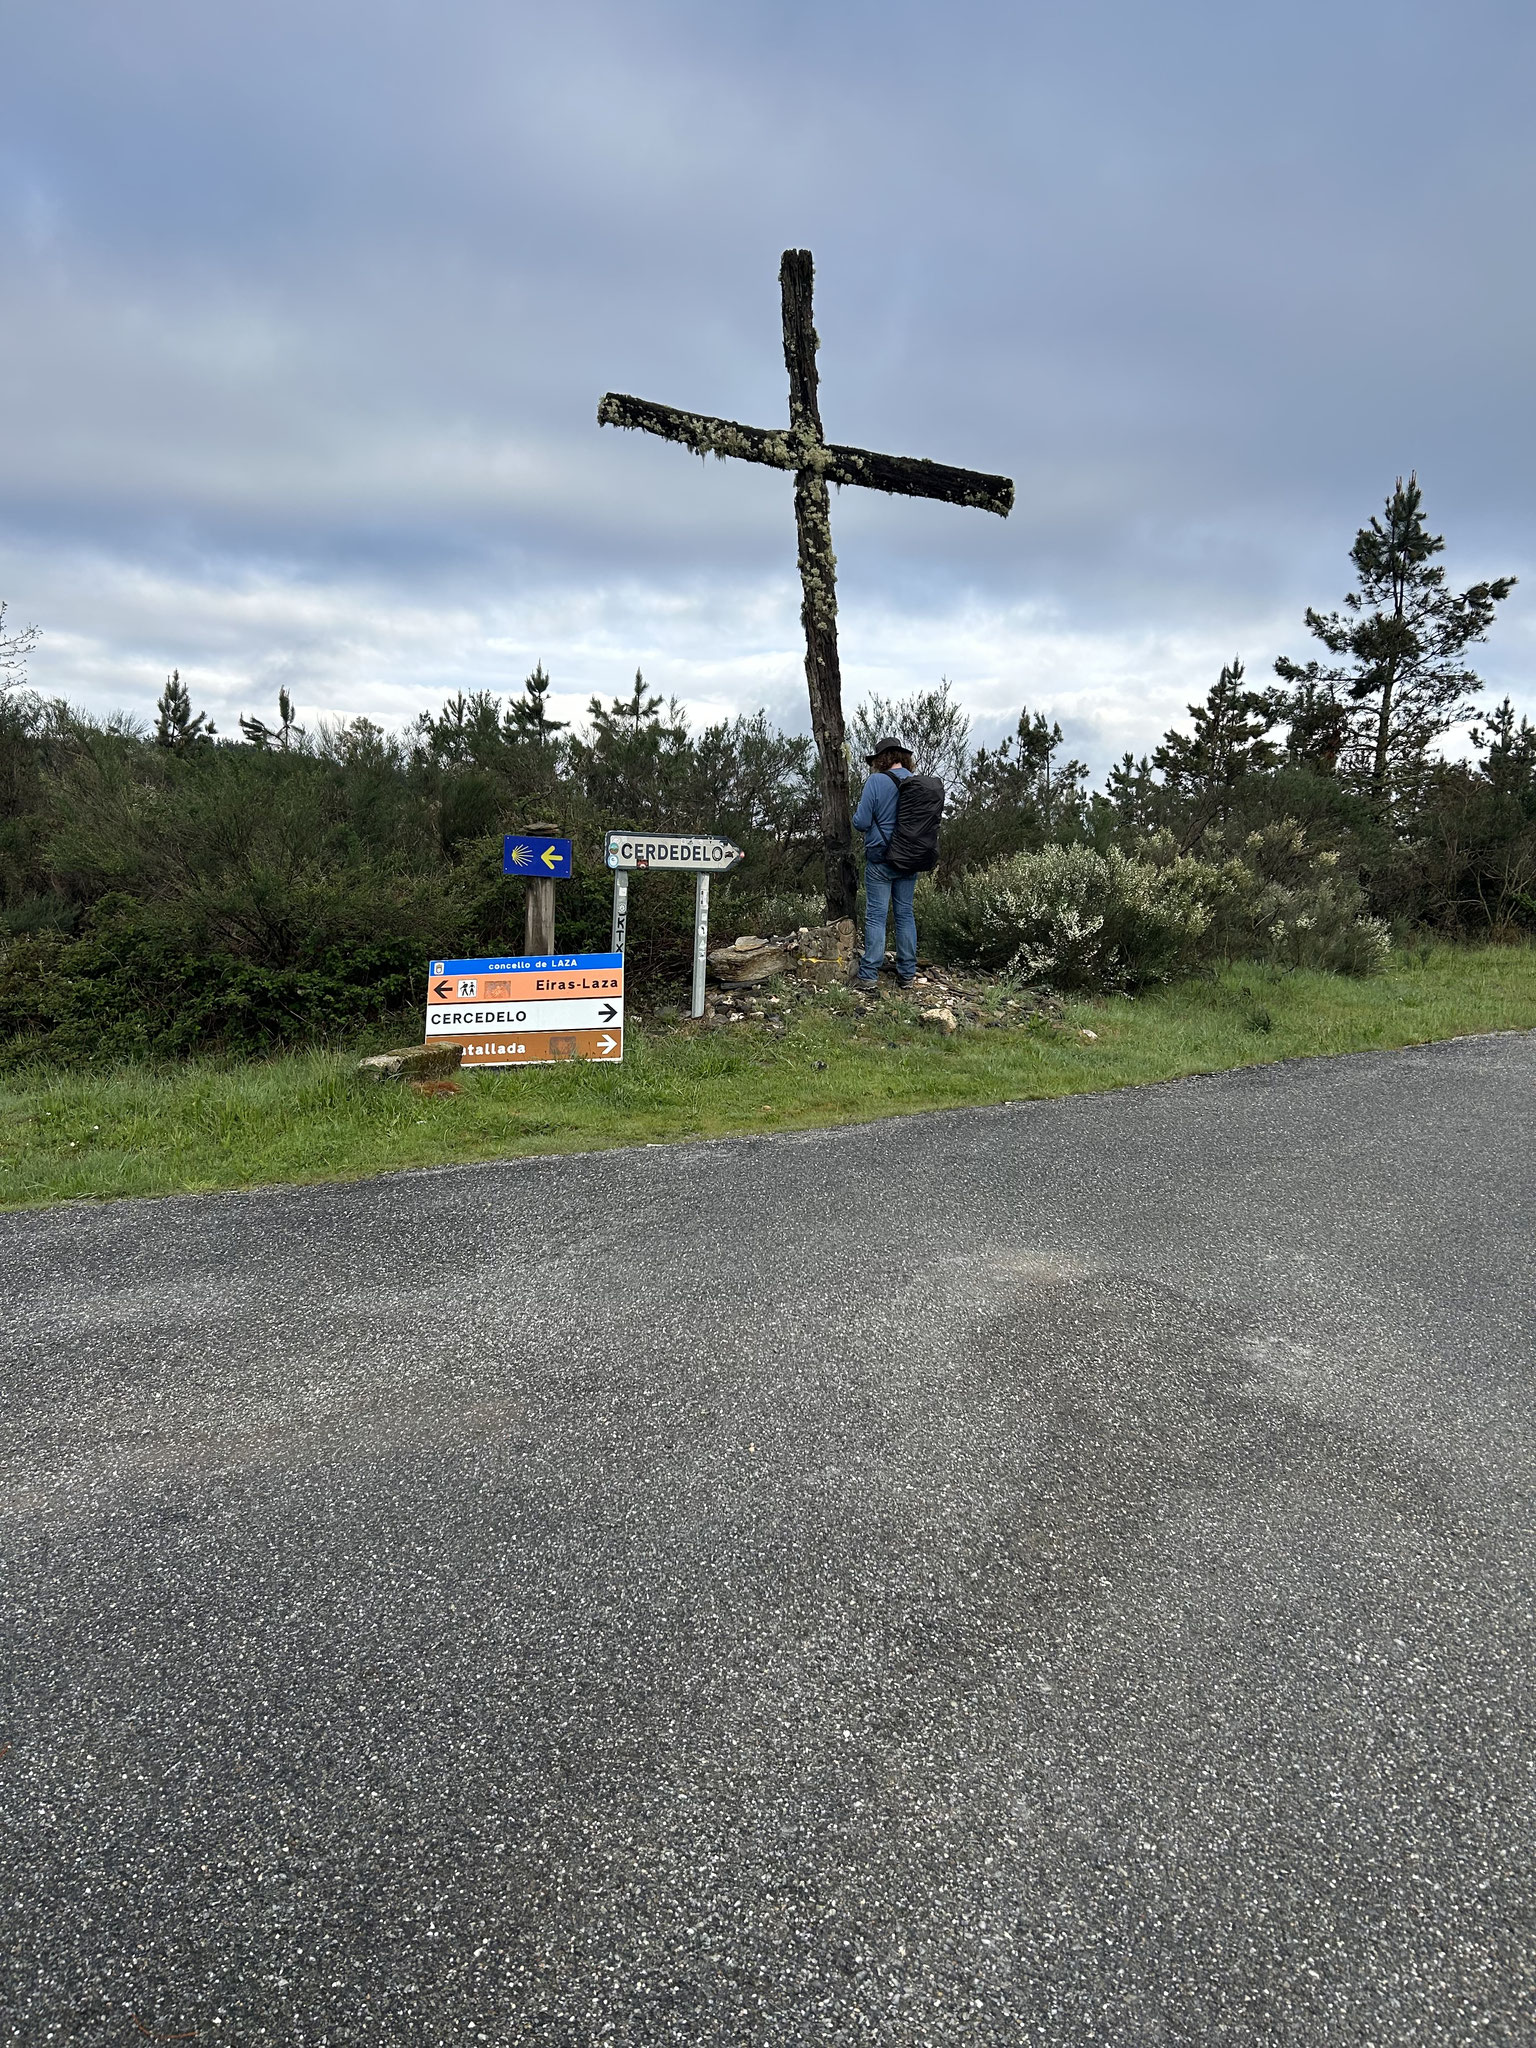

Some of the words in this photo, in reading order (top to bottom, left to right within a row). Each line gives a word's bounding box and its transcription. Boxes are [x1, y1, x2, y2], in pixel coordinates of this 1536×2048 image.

[621, 842, 723, 861] CERDEDELO
[488, 961, 531, 970] concello
[535, 960, 547, 968] de
[551, 959, 578, 968] LAZA
[536, 978, 618, 991] Eiras-Laza
[431, 1010, 527, 1025] CERCEDELO
